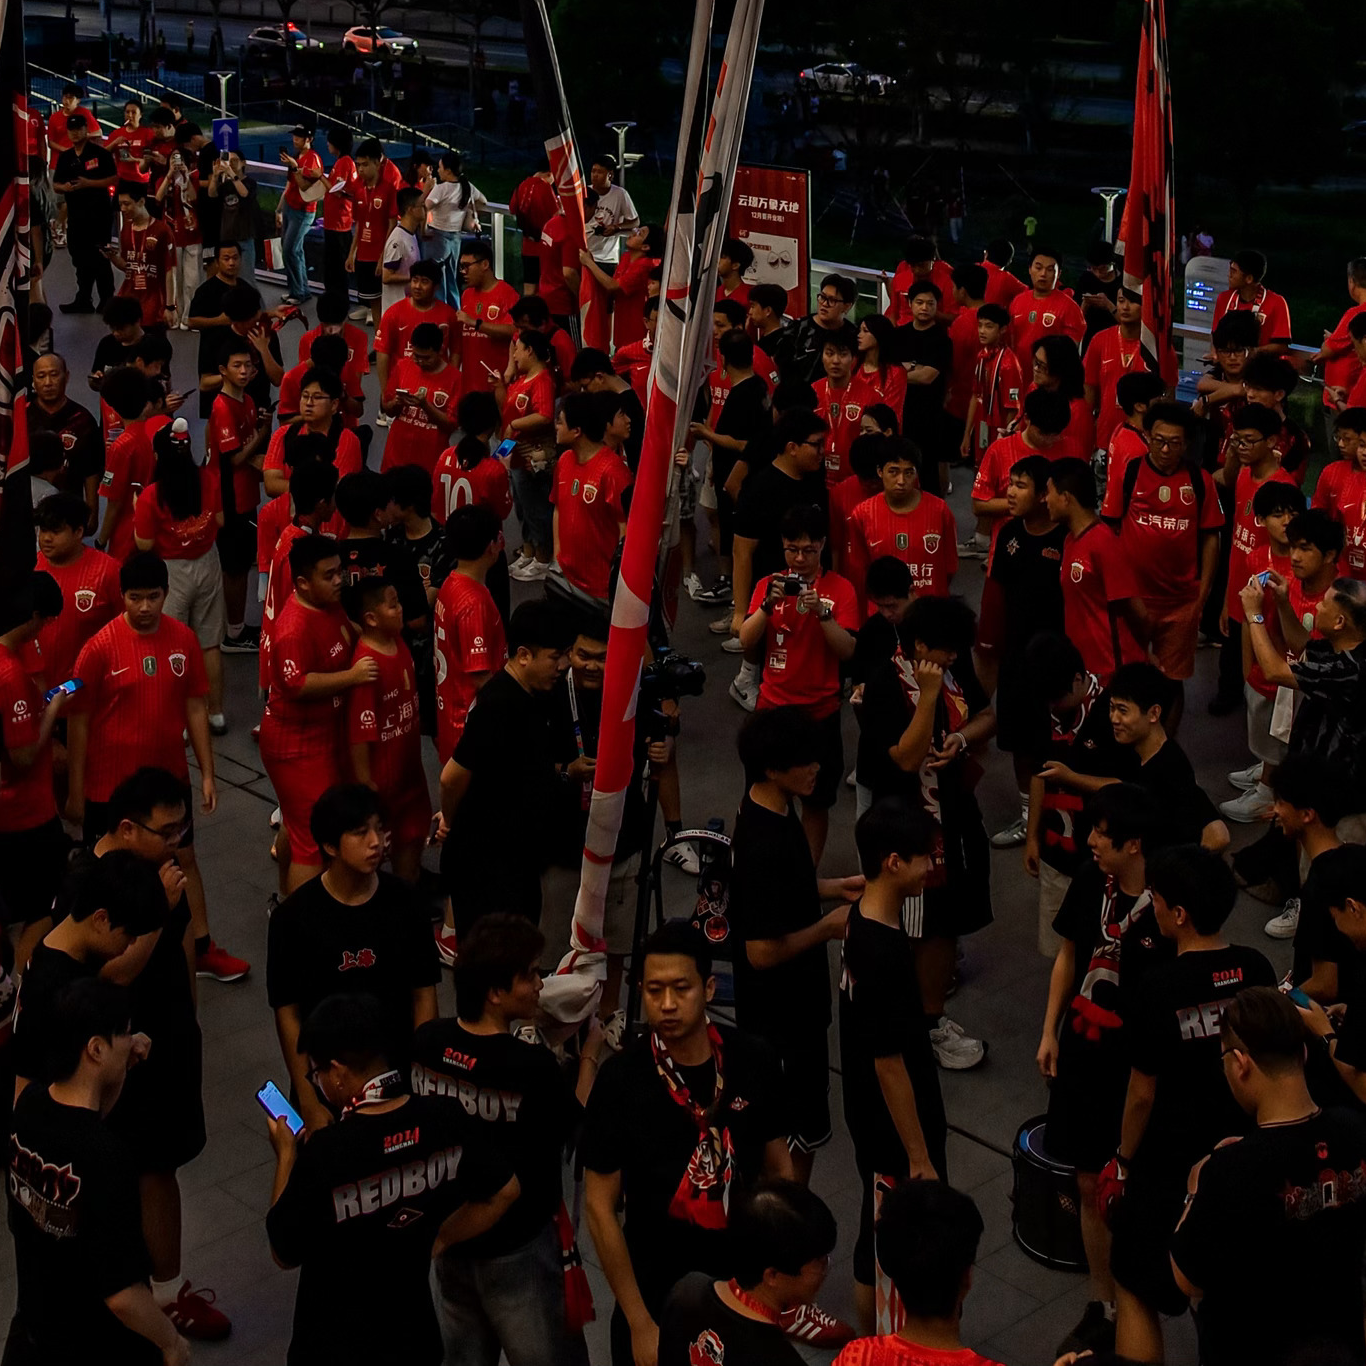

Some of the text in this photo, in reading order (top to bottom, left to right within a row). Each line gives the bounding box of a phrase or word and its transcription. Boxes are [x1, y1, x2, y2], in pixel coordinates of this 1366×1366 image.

[440, 473, 473, 522] 10
[1135, 514, 1189, 530] 上汽荣威
[913, 578, 932, 587] nghai
[338, 948, 376, 972] 上海
[1212, 967, 1243, 982] 2014
[1176, 998, 1226, 1040] RE
[444, 1047, 477, 1071] 2014
[411, 1061, 523, 1122] REDBOY
[384, 1126, 420, 1149] 2014
[332, 1145, 463, 1224] REDBOY
